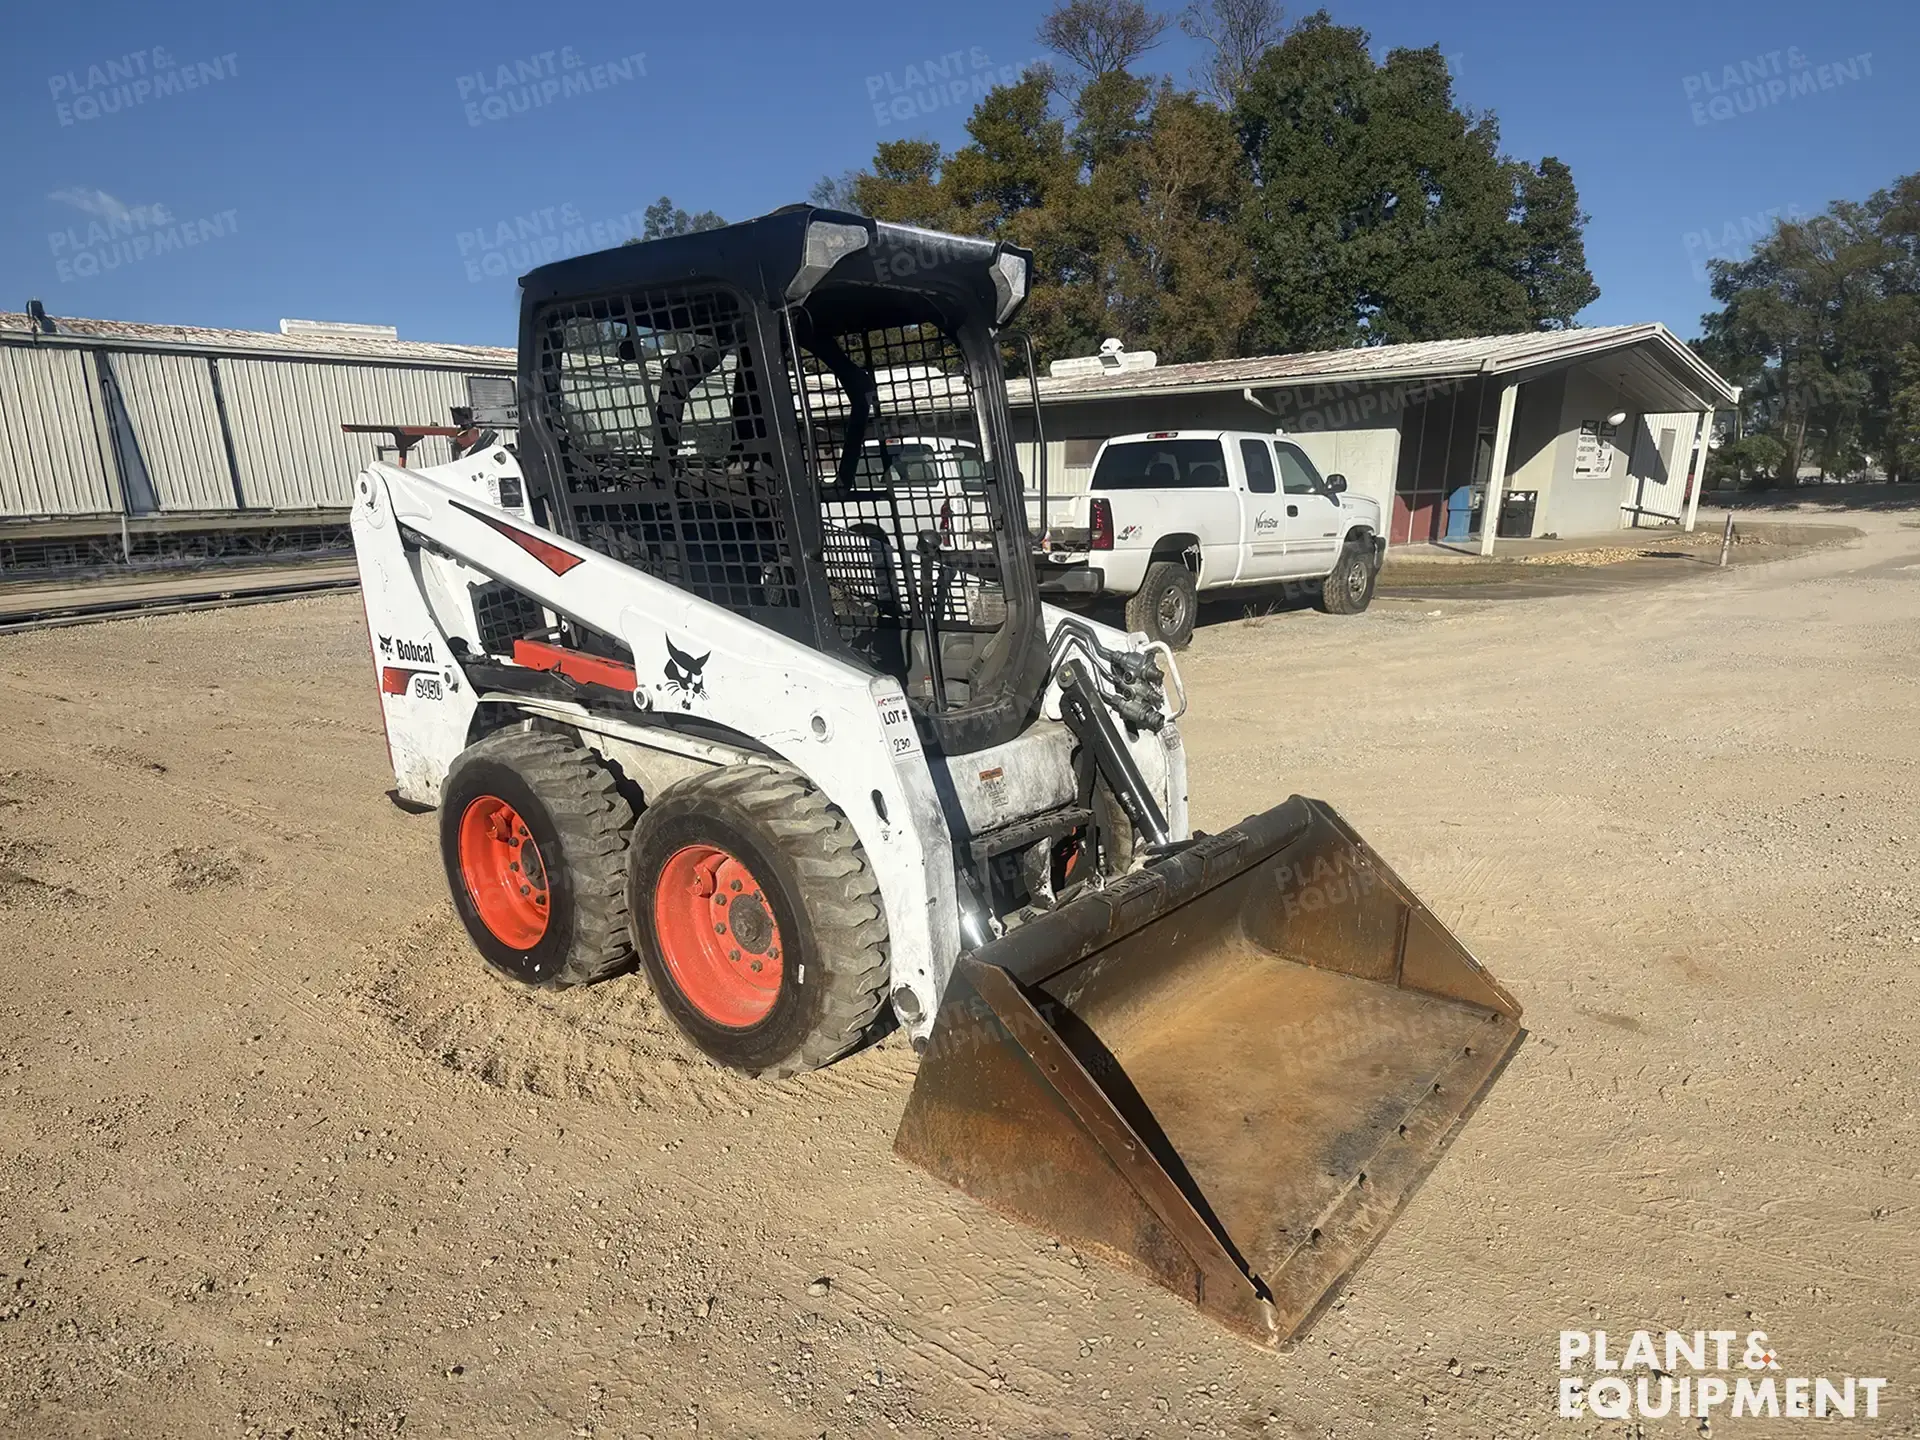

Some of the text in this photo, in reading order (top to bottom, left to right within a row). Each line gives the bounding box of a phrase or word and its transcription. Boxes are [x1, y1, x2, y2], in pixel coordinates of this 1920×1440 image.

[396, 639, 435, 664] Bobcat
[415, 678, 443, 700] S450
[882, 710, 901, 725] LOT
[893, 738, 911, 752] 230
